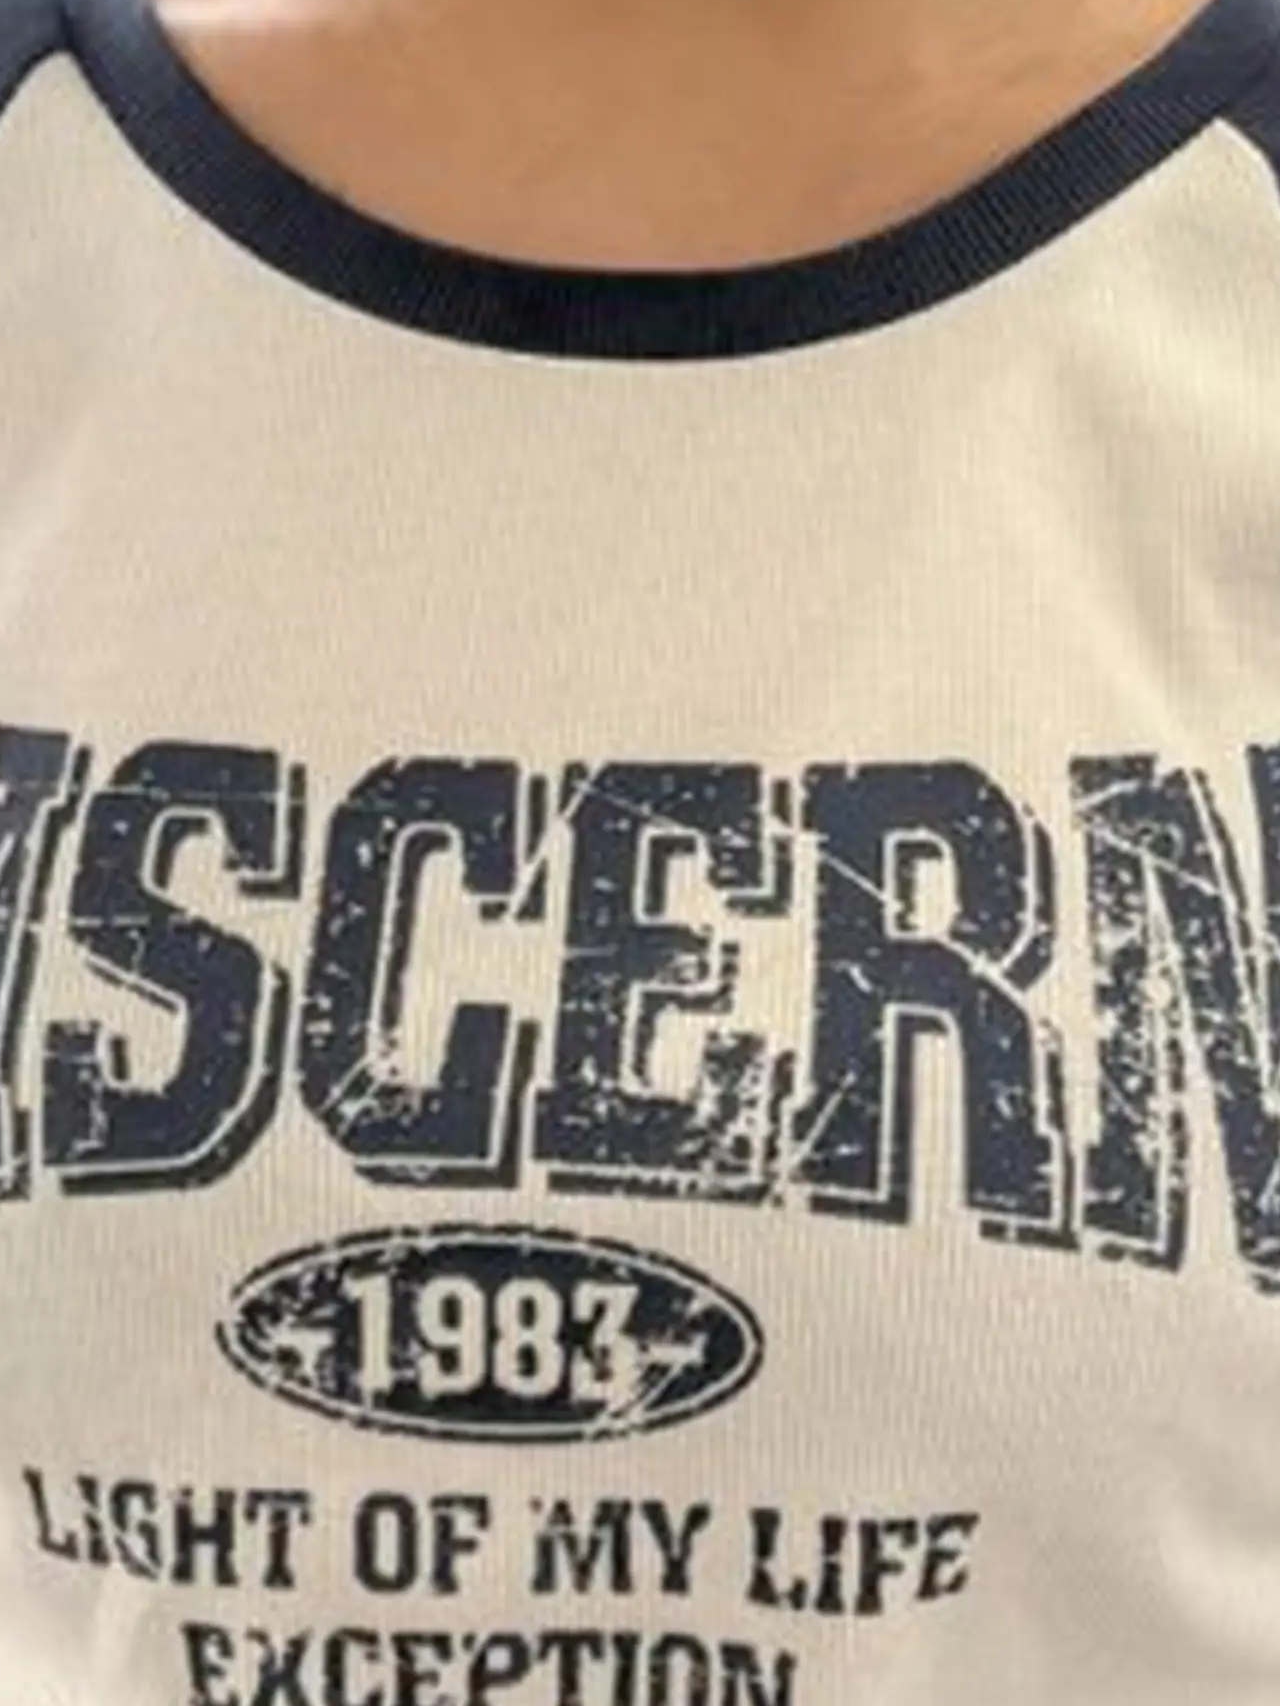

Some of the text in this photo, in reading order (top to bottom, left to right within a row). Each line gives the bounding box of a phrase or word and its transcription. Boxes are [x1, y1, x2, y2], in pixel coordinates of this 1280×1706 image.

[342, 1272, 642, 1404] 1983
[21, 1468, 980, 1616] LIGHT OF MY LIFE
